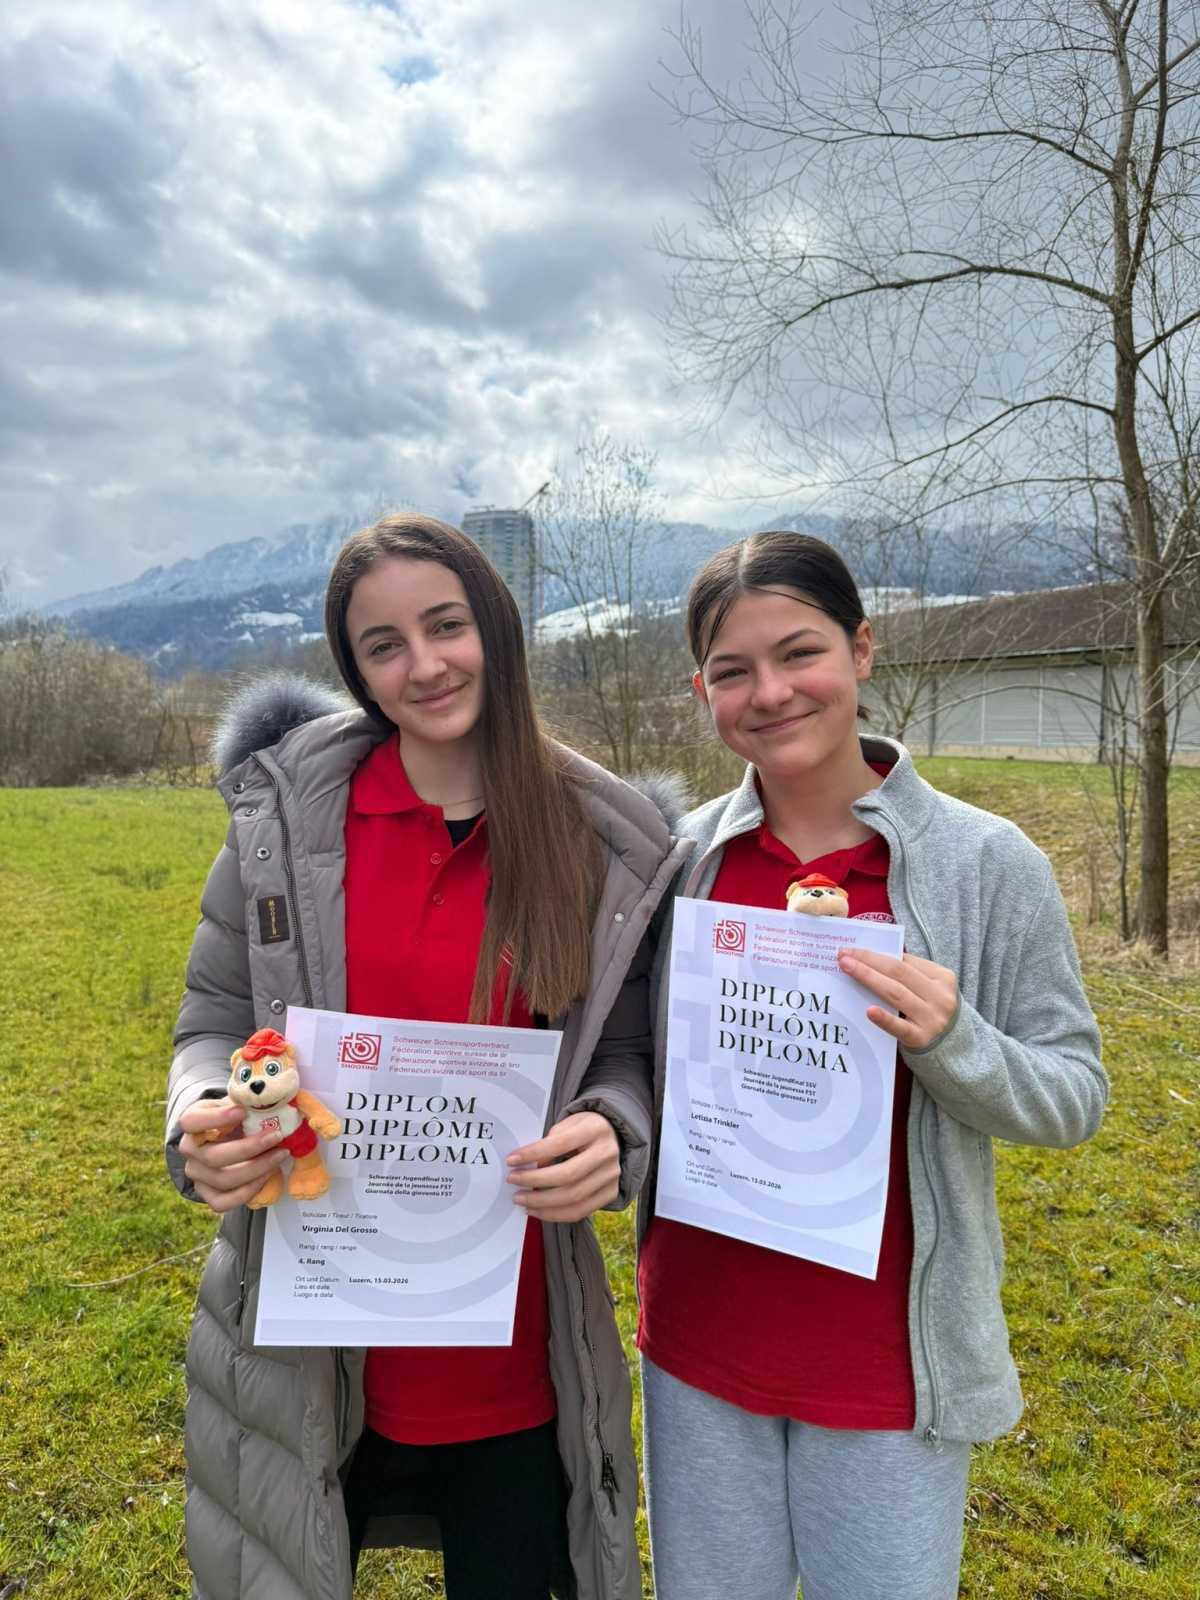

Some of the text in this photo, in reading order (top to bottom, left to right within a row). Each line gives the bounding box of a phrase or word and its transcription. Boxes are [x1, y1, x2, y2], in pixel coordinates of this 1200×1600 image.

[721, 978, 830, 1014] DIPLOM
[720, 1005, 849, 1046] DIPLÔME
[719, 1030, 849, 1073] DIPLOMA
[743, 1068, 770, 1078] Schweizer
[346, 1092, 477, 1114] DIPLOM
[343, 1117, 494, 1140] DIPLÔME
[713, 1117, 739, 1128] Trinkler
[340, 1142, 489, 1165] DIPLOMA
[695, 1145, 710, 1155] Rang
[302, 1225, 333, 1234] Virginia
[350, 1226, 378, 1234] Grosso
[298, 1243, 315, 1251] Rang
[306, 1258, 326, 1266] Rang
